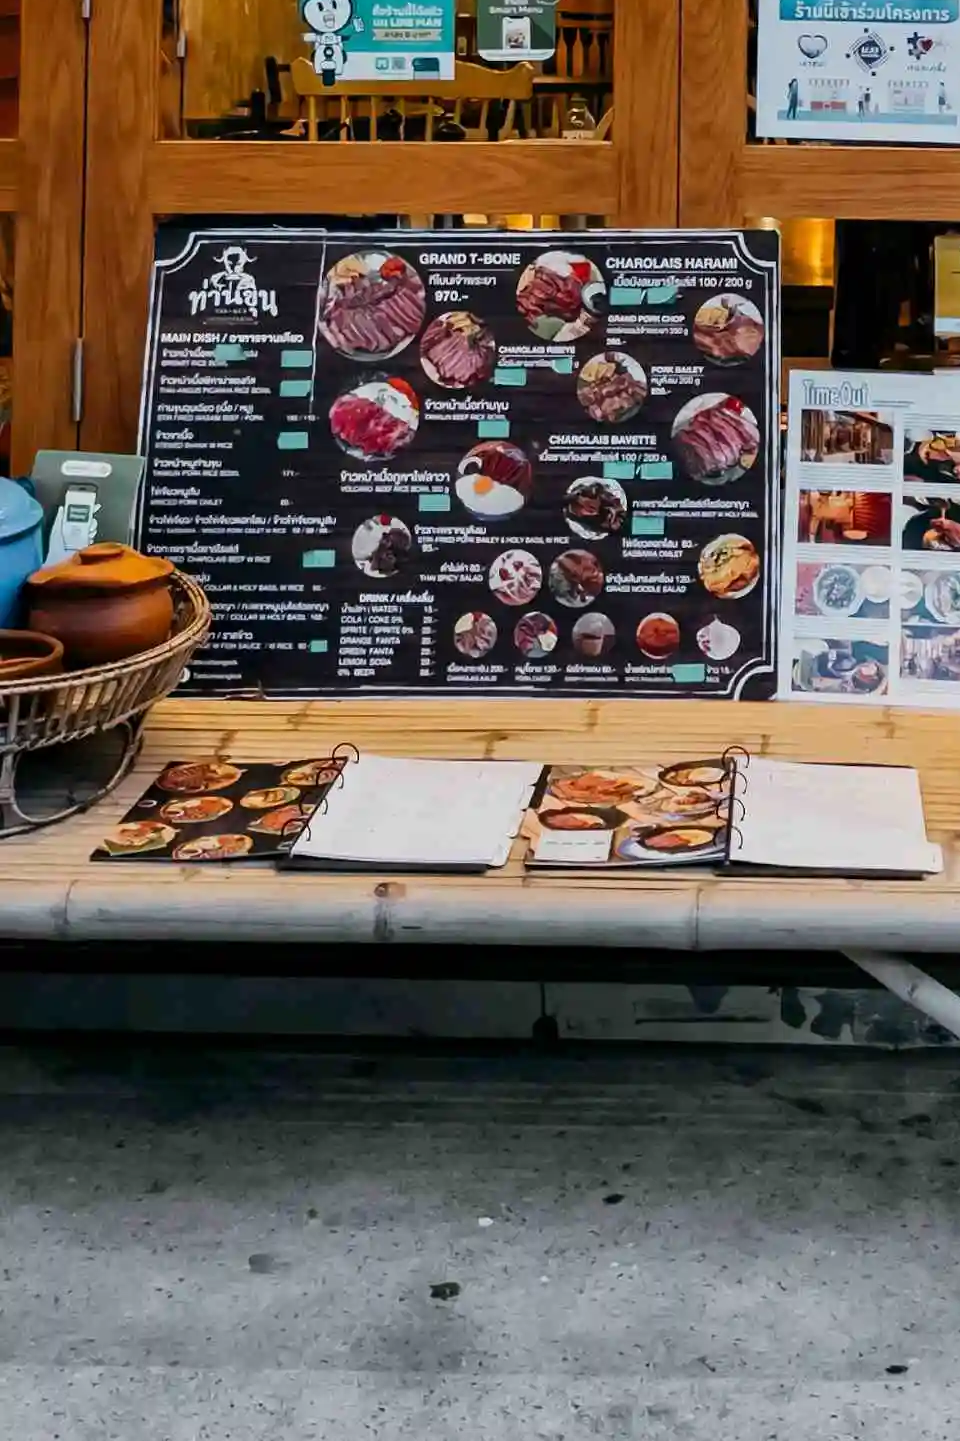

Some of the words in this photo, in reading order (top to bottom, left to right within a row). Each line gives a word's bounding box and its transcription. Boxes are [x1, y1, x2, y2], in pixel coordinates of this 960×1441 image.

[419, 253, 467, 265] GRAND
[469, 253, 521, 265] T-BONE
[605, 257, 683, 269] CHAROLAIS
[685, 257, 738, 269] HARAMI
[699, 278, 717, 287] 100
[725, 278, 744, 287] 200
[745, 279, 753, 290] g
[188, 278, 278, 318] ท่านขุน
[434, 290, 469, 302] 970.-
[161, 333, 191, 343] MAIN
[193, 333, 220, 343] DISH
[548, 435, 610, 445] CHAROLAIS
[611, 435, 657, 445] BAVETTE
[359, 593, 389, 603] DRINK
[341, 615, 361, 624] COLA
